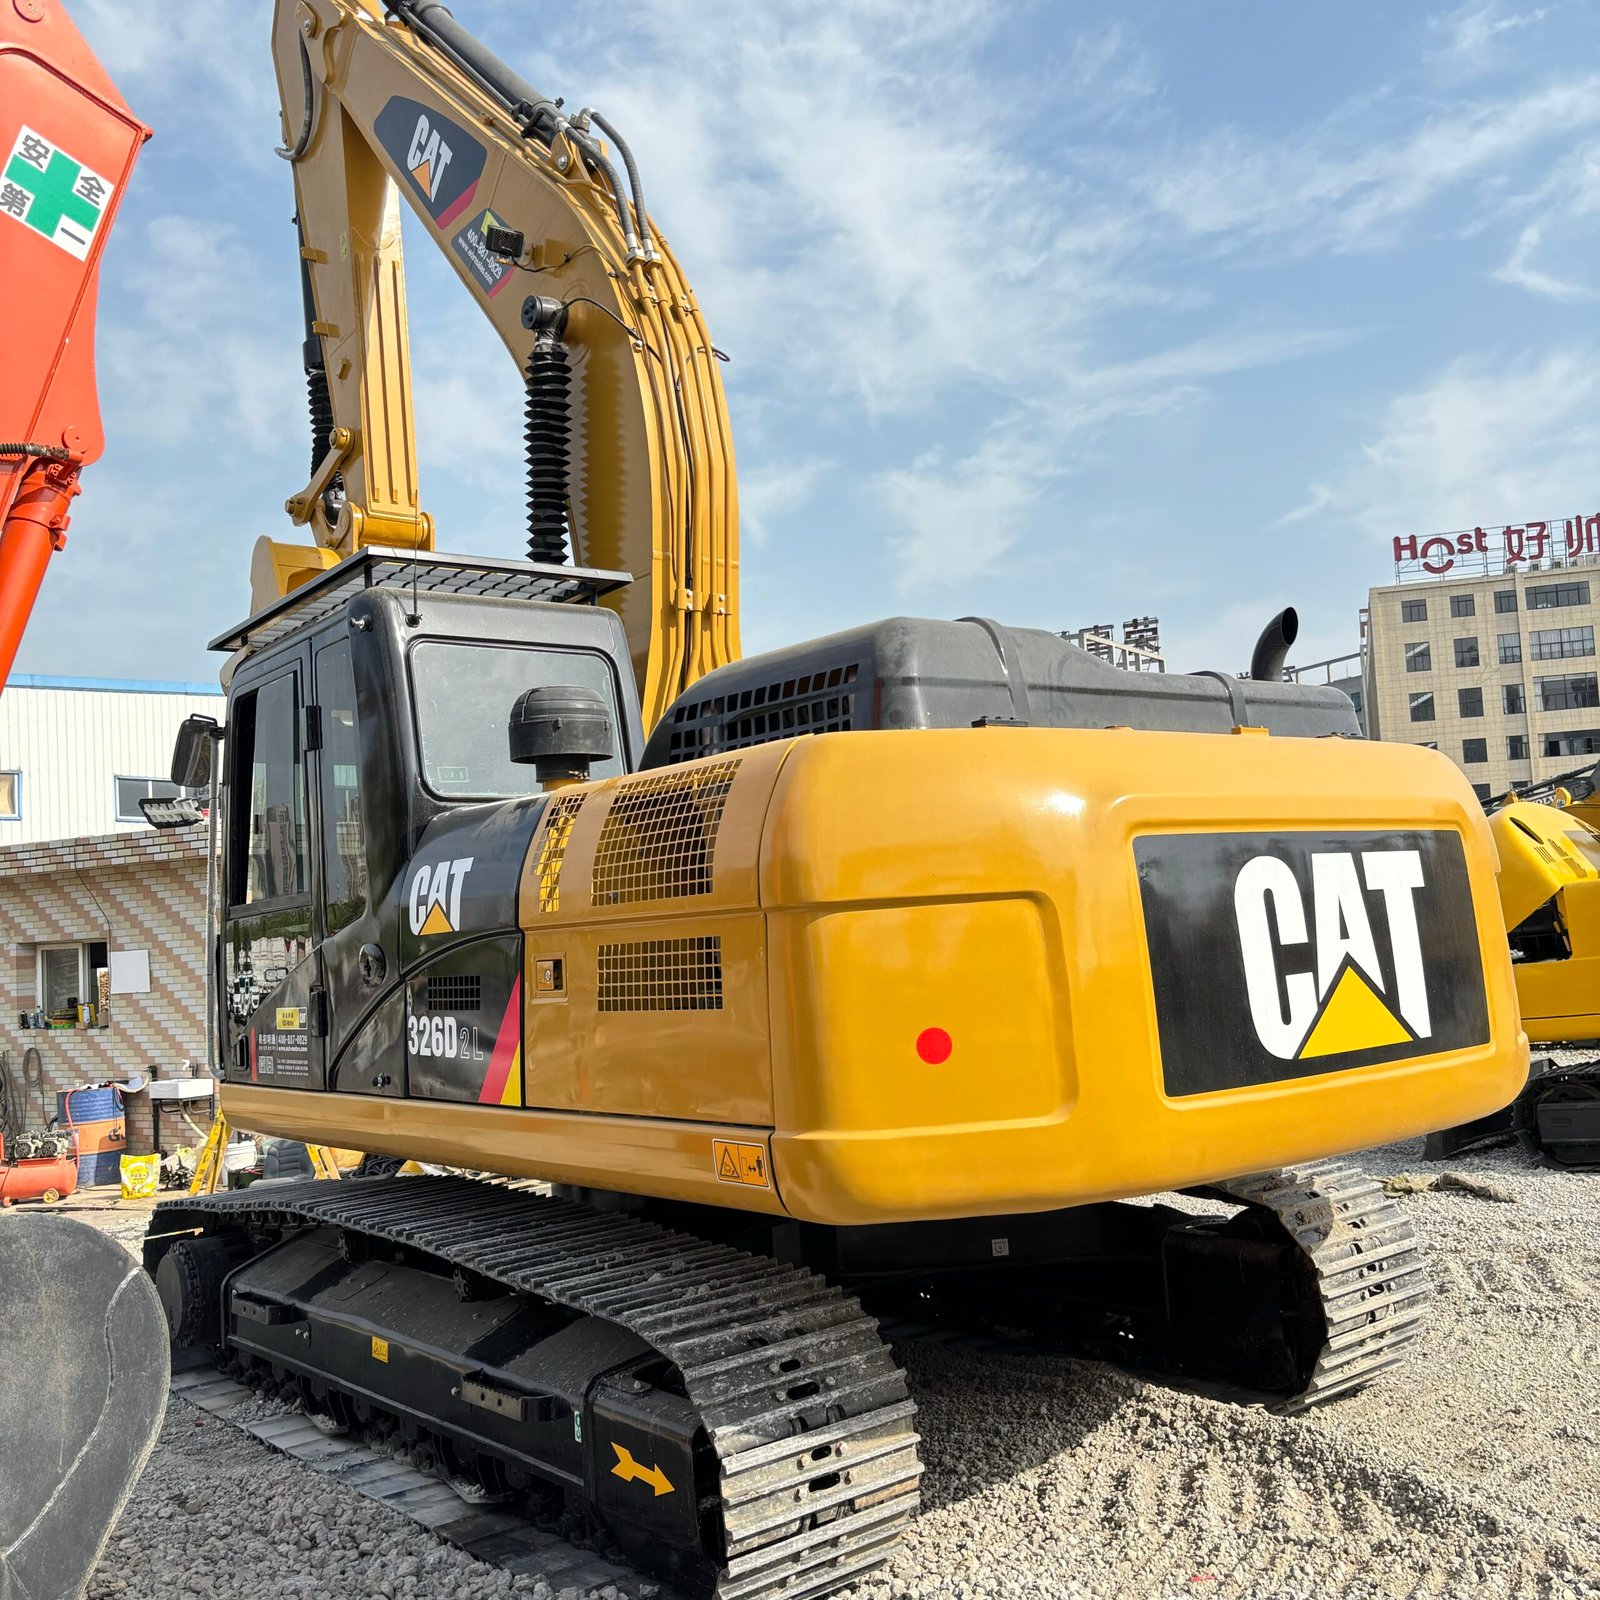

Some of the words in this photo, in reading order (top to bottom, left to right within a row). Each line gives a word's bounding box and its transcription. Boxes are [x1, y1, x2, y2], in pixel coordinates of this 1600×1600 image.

[407, 114, 453, 203] CAT
[409, 857, 474, 936] CAT
[1234, 850, 1432, 1060] CAT
[408, 1015, 457, 1058] 326D
